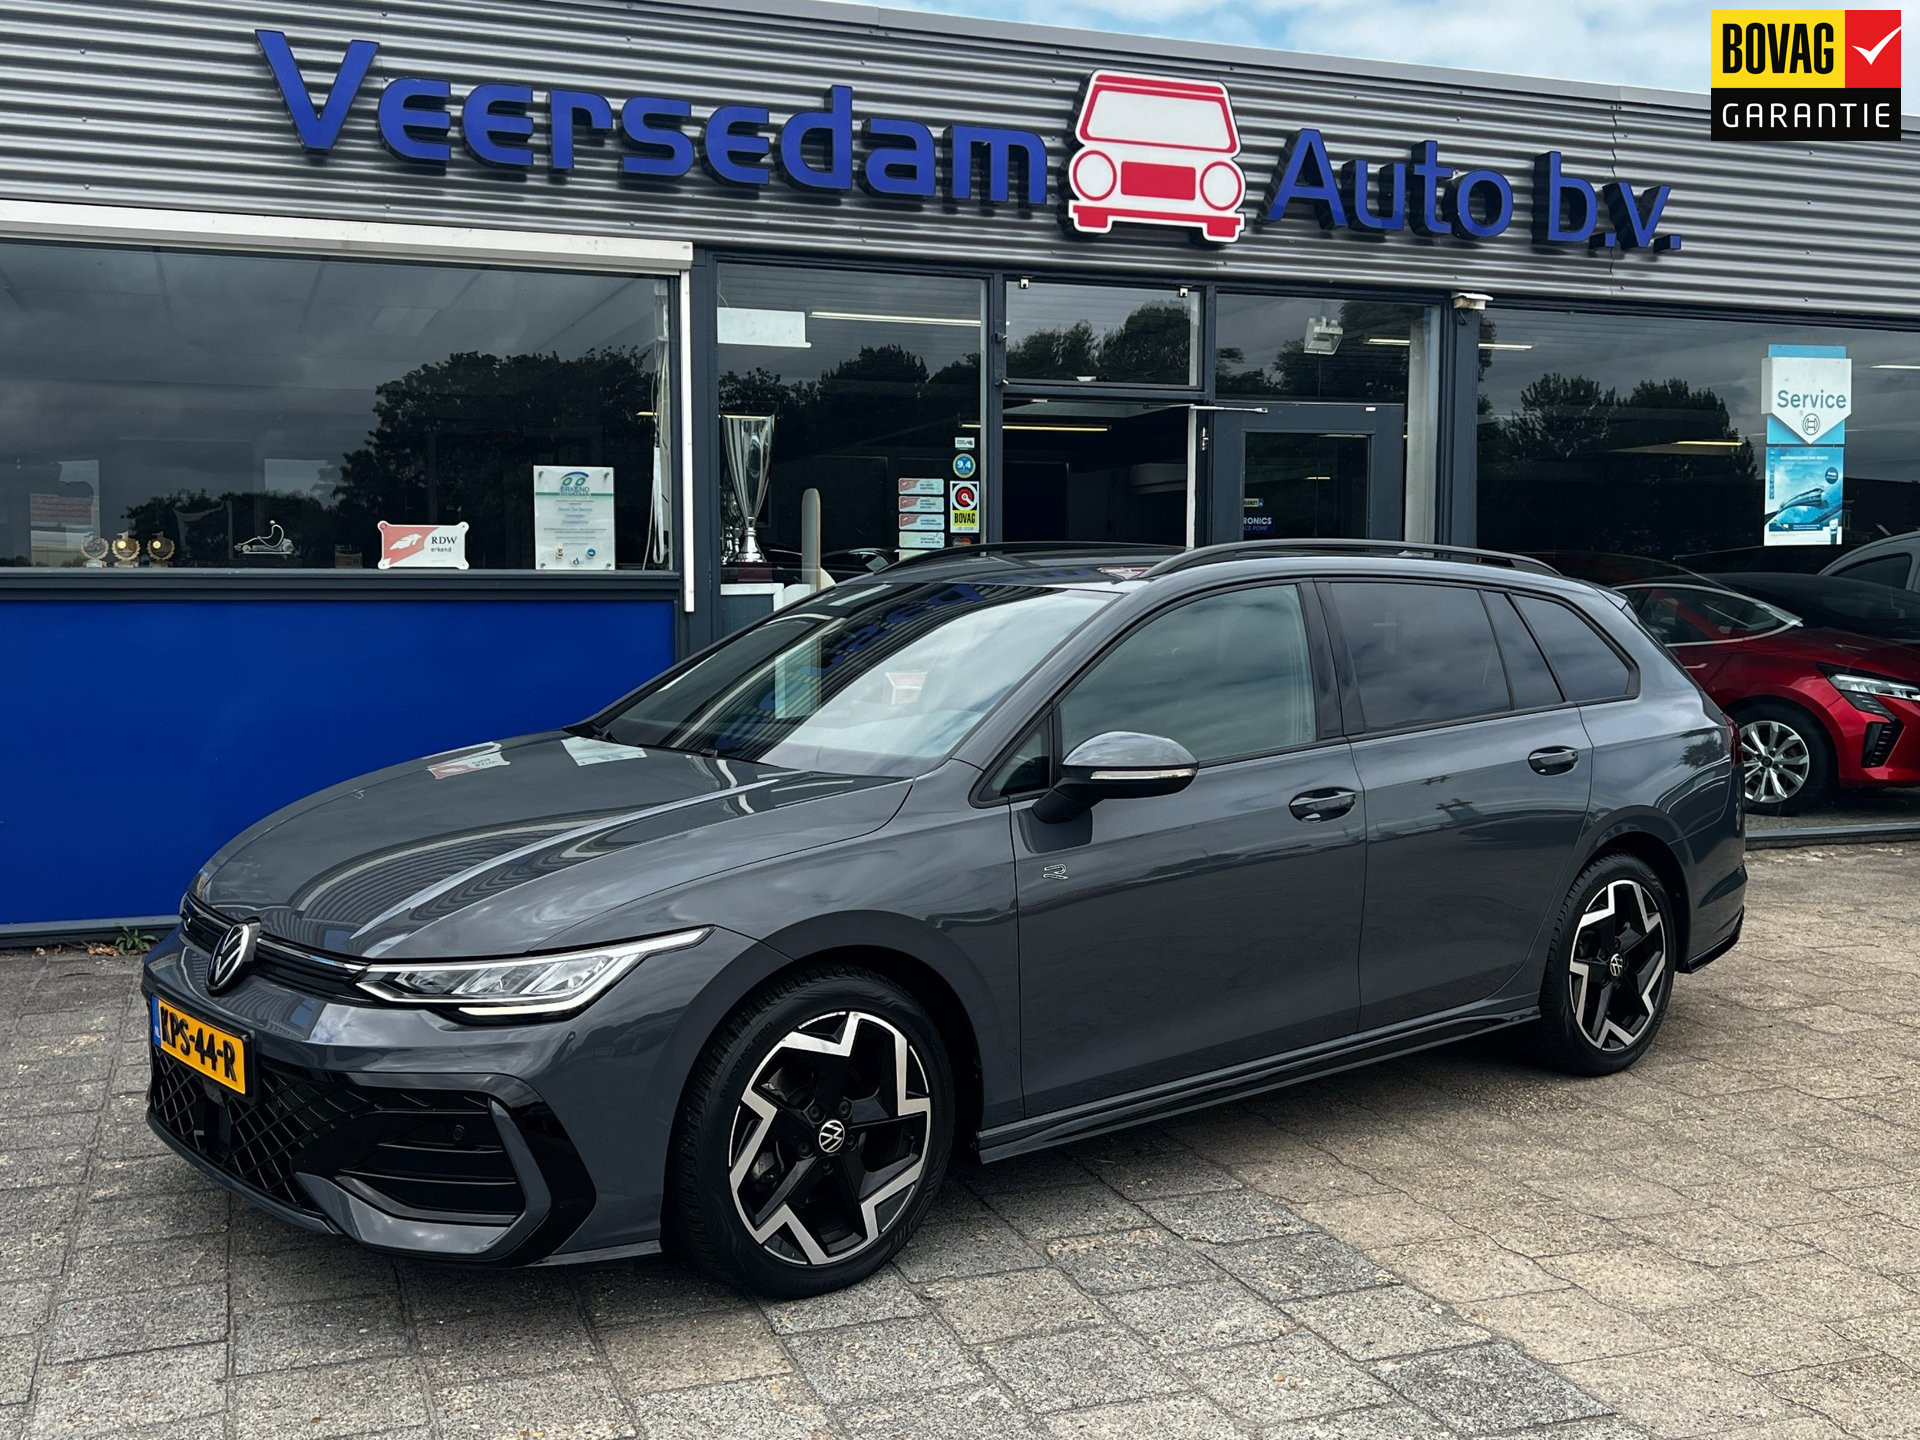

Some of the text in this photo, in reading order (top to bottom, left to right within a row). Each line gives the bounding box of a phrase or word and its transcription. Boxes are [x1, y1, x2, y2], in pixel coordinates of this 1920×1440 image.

[254, 29, 1683, 251] Veersedam Auto b.v.
[1777, 389, 1847, 409] Service
[954, 512, 976, 524] BOVAG
[431, 536, 458, 545] RDW
[160, 1005, 238, 1082] KPS-44-R
